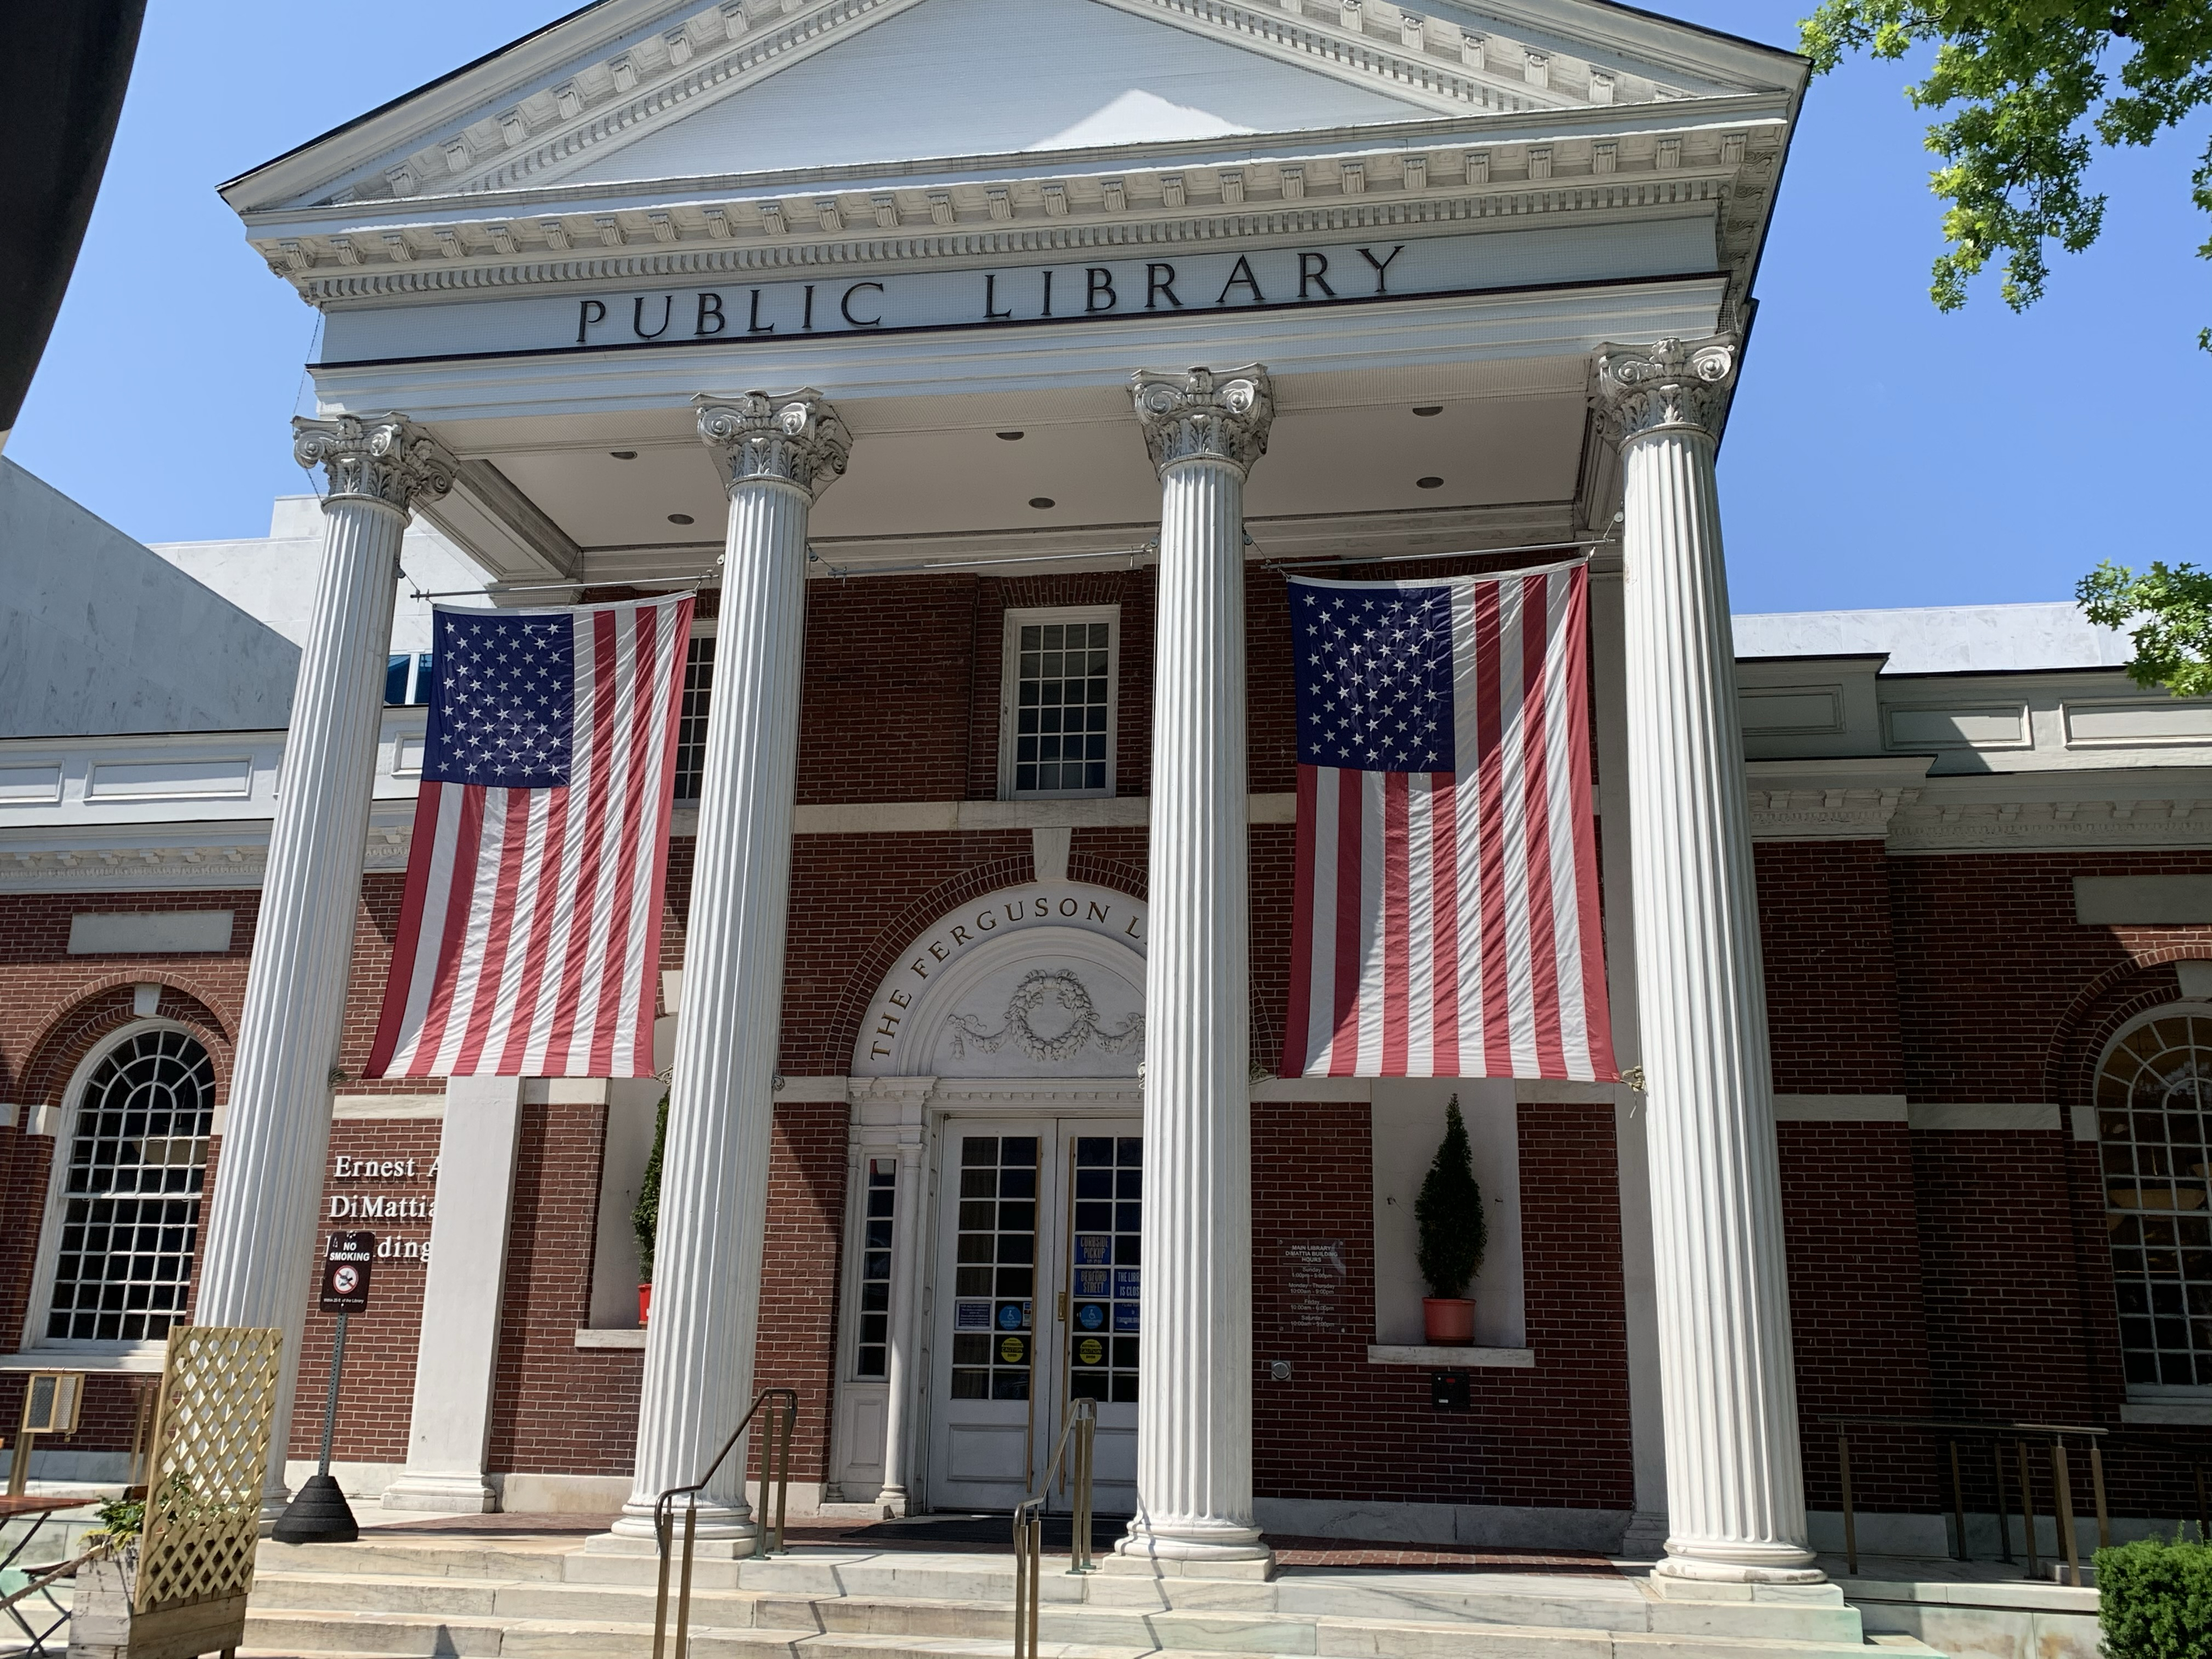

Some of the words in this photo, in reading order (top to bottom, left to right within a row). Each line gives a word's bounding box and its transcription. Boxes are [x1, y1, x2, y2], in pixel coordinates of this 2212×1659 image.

[576, 282, 884, 342] PUBLIC
[983, 245, 1406, 318] LIBRARY
[870, 989, 913, 1061] THE
[910, 897, 1110, 980] FERGUSON
[1125, 915, 1147, 945] L
[333, 1155, 415, 1177] Ernest
[343, 1242, 357, 1251] NO
[1081, 1236, 1109, 1248] CURBSIDE
[329, 1252, 370, 1261] SMOKING
[1084, 1248, 1105, 1259] PICKUP
[1081, 1271, 1107, 1282] BEDFORD
[1118, 1272, 1127, 1282] THE
[1128, 1272, 1141, 1283] LIBR
[1084, 1282, 1104, 1294] STREET
[1120, 1286, 1125, 1296] IS
[1126, 1286, 1140, 1296] CLOS
